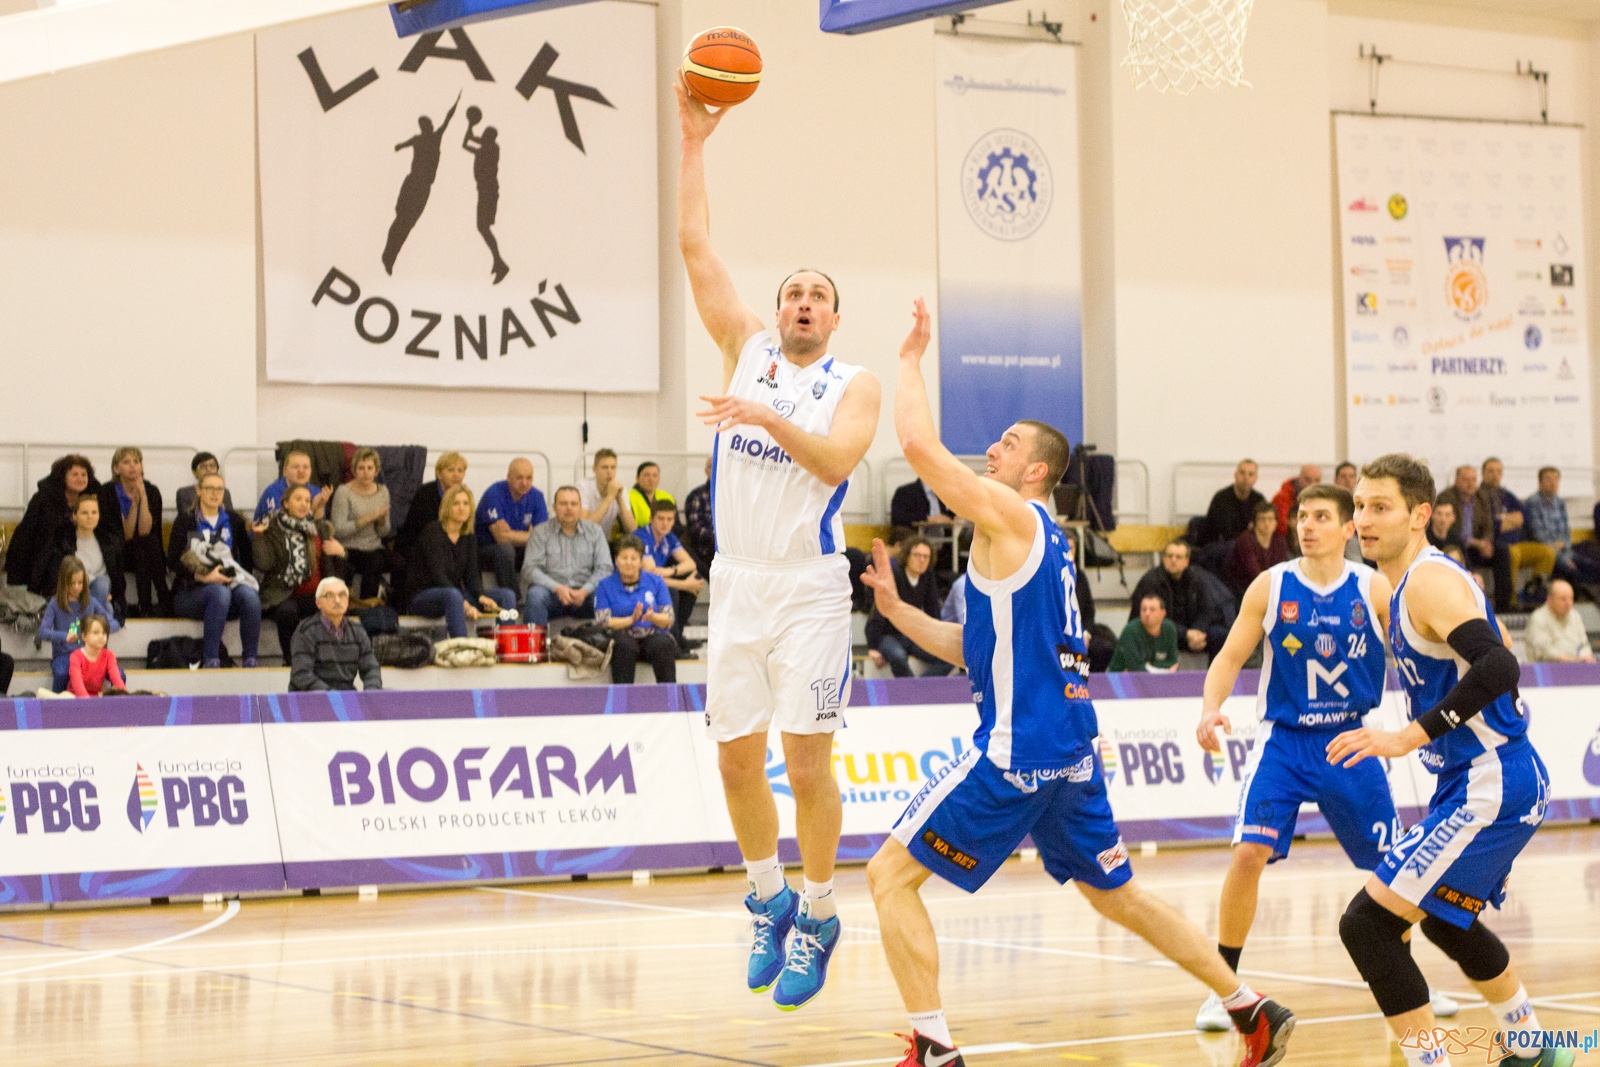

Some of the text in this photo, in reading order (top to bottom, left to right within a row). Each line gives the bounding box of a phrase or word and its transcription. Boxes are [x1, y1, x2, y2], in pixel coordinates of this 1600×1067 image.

[707, 31, 753, 46] molten
[311, 266, 581, 361] POZNAŃ
[1431, 356, 1508, 375] PARTNERZY:
[1347, 632, 1367, 659] 24
[811, 677, 841, 711] 12
[1114, 728, 1178, 742] fundacja
[6, 763, 96, 779] fundacja
[157, 758, 243, 775] fundacja
[327, 742, 638, 806] BIOFARM
[1118, 741, 1186, 787] PBG
[10, 780, 102, 835] PBG
[161, 775, 249, 828] PBG
[361, 804, 619, 832] POLSKI PRODUCENT LEKÓW
[931, 837, 979, 871] WA-BET
